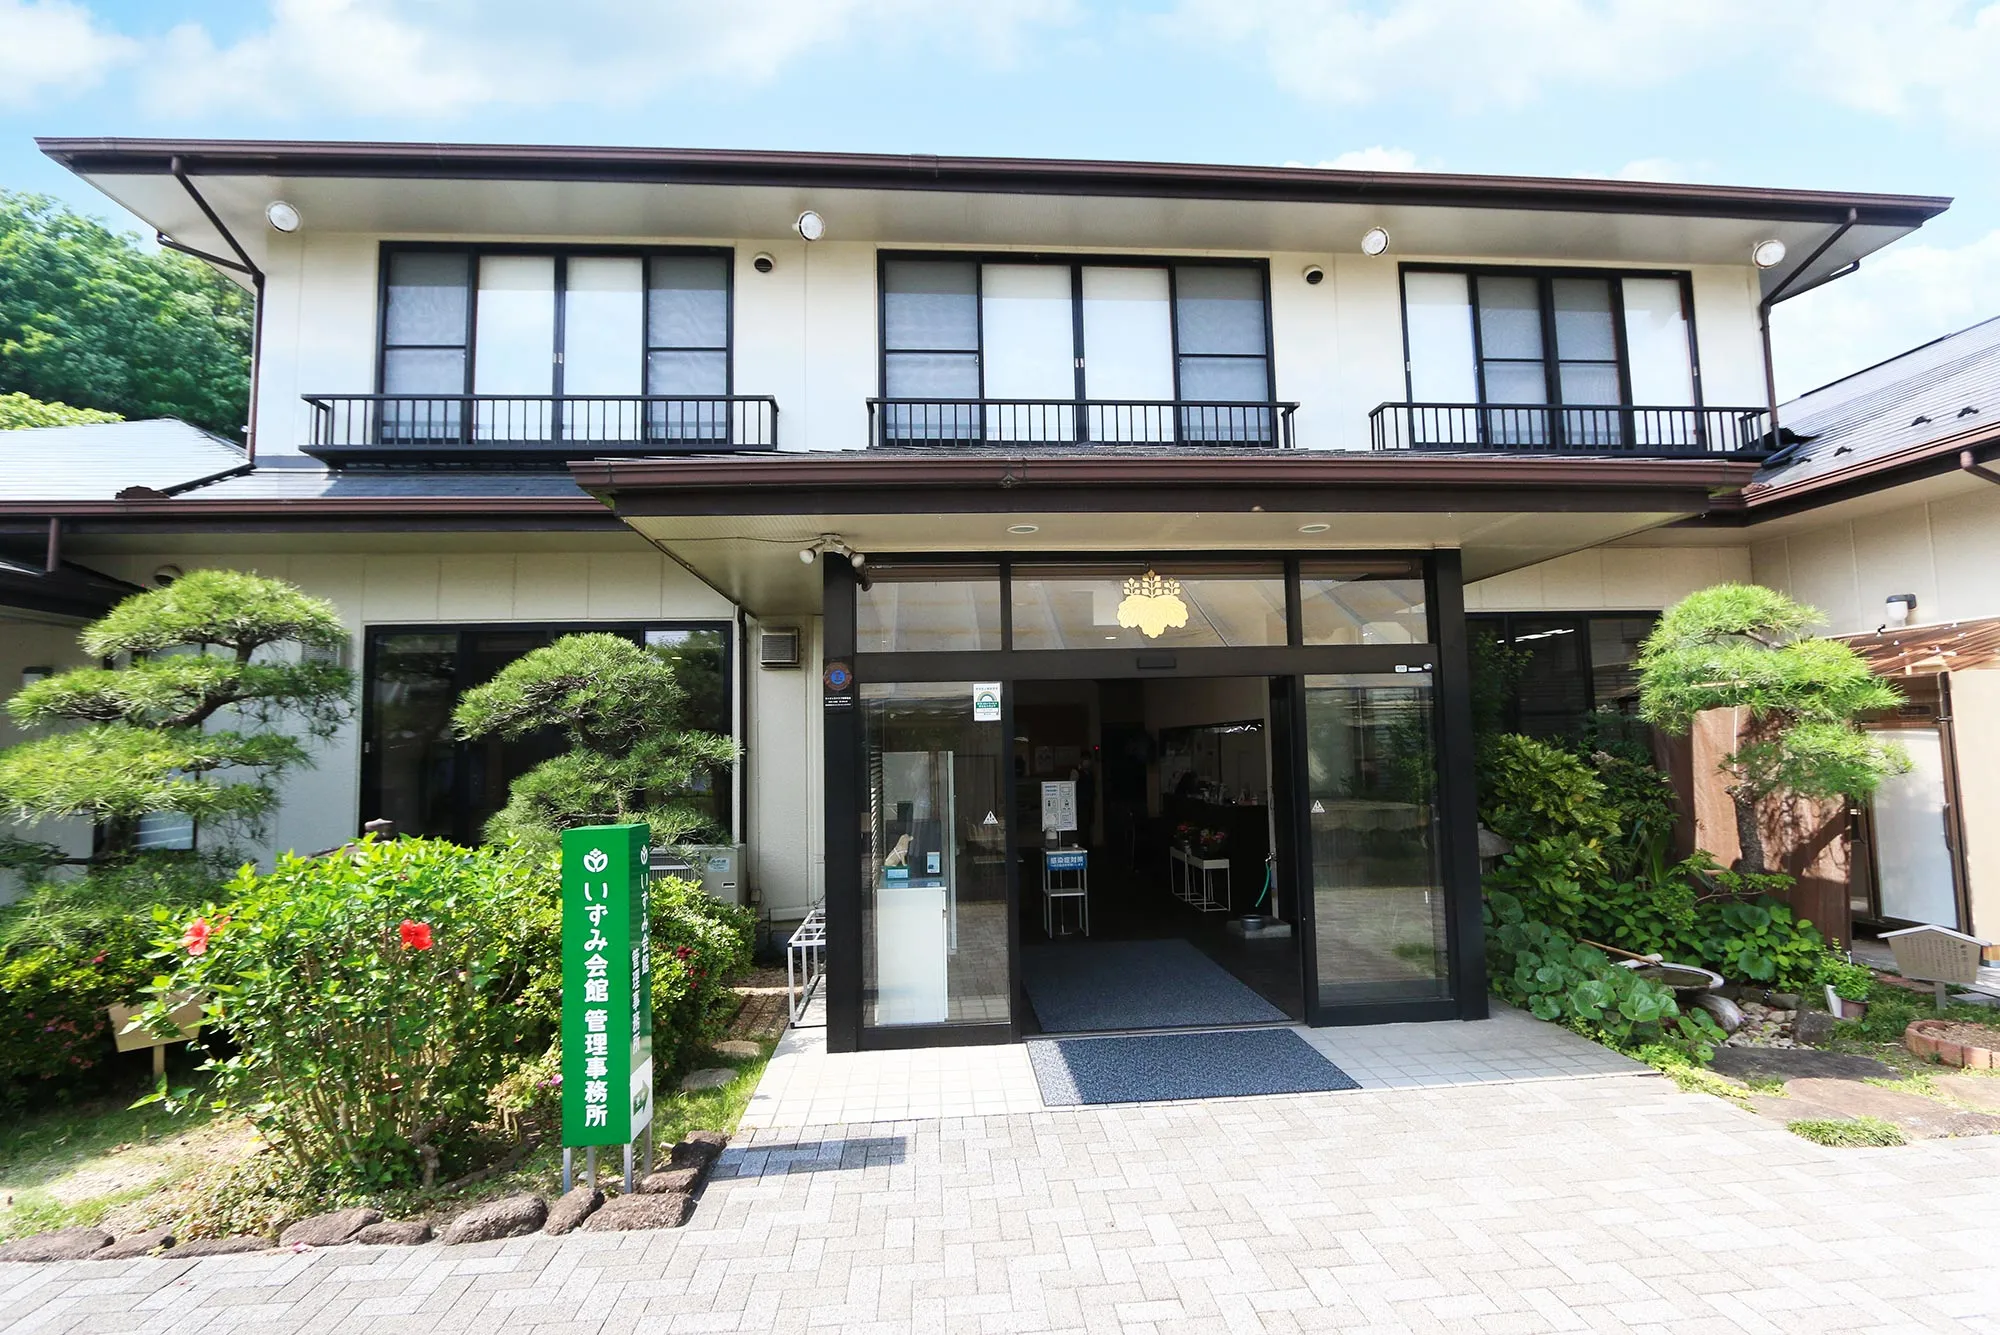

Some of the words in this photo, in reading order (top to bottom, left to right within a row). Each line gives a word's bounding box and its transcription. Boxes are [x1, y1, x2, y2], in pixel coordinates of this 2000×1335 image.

[584, 882, 609, 1003] いずみ会館
[640, 873, 650, 976] いずみ会館
[631, 947, 641, 1056] 管理事務所
[584, 1008, 609, 1128] 管理事務所
